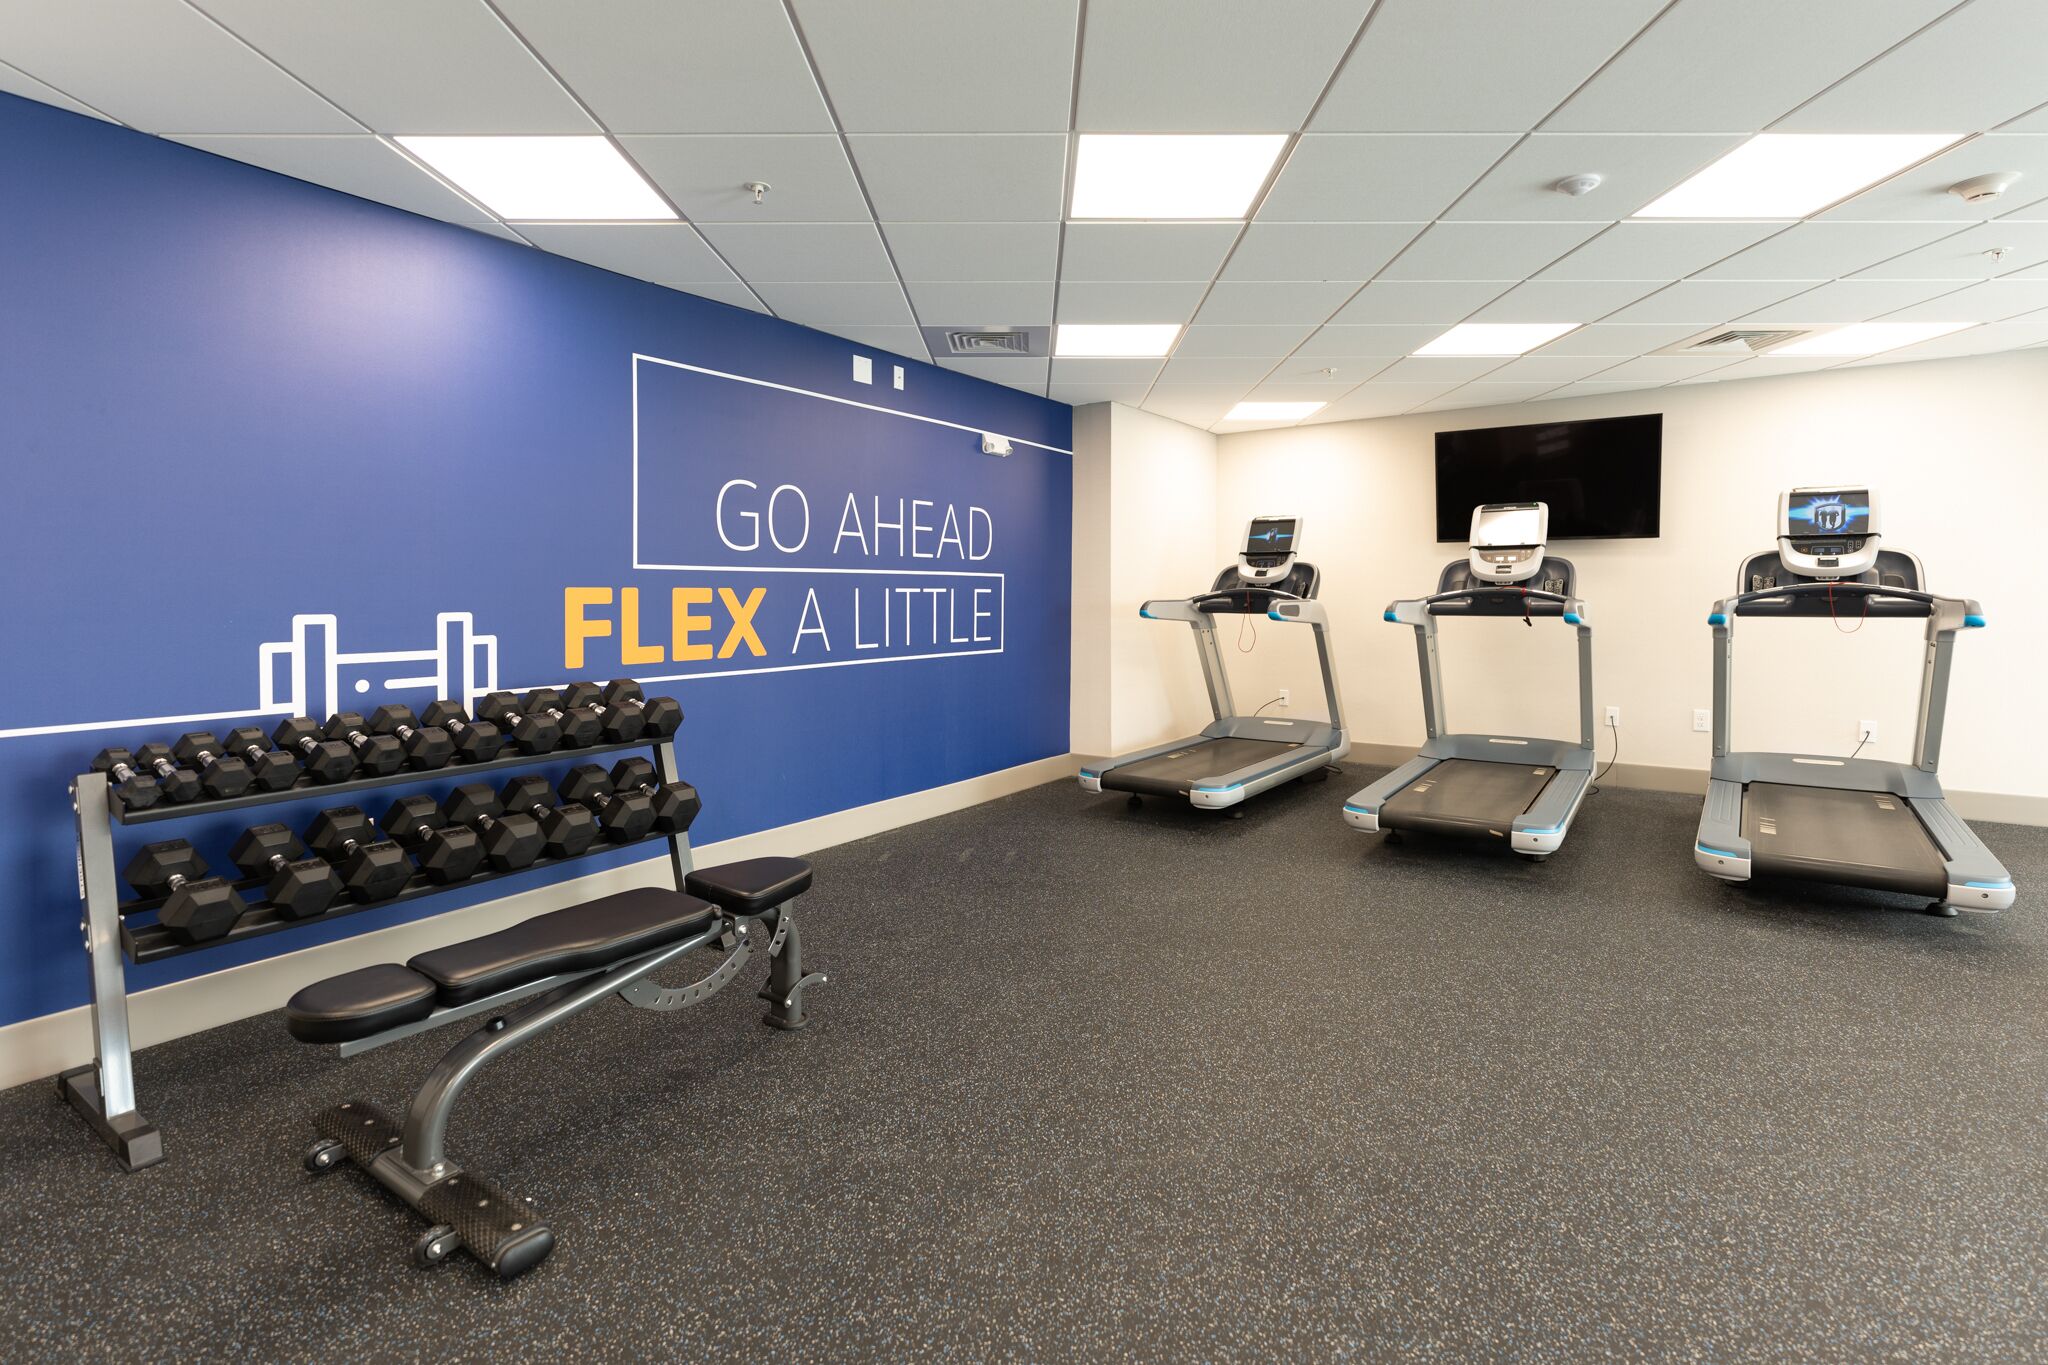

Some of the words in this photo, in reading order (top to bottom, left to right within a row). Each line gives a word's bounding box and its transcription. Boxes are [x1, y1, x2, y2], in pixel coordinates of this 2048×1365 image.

[716, 478, 810, 554] GO
[832, 493, 993, 560] AHEAD
[564, 587, 768, 669] FLEX
[792, 587, 831, 654] A
[856, 587, 992, 649] LITTLE
